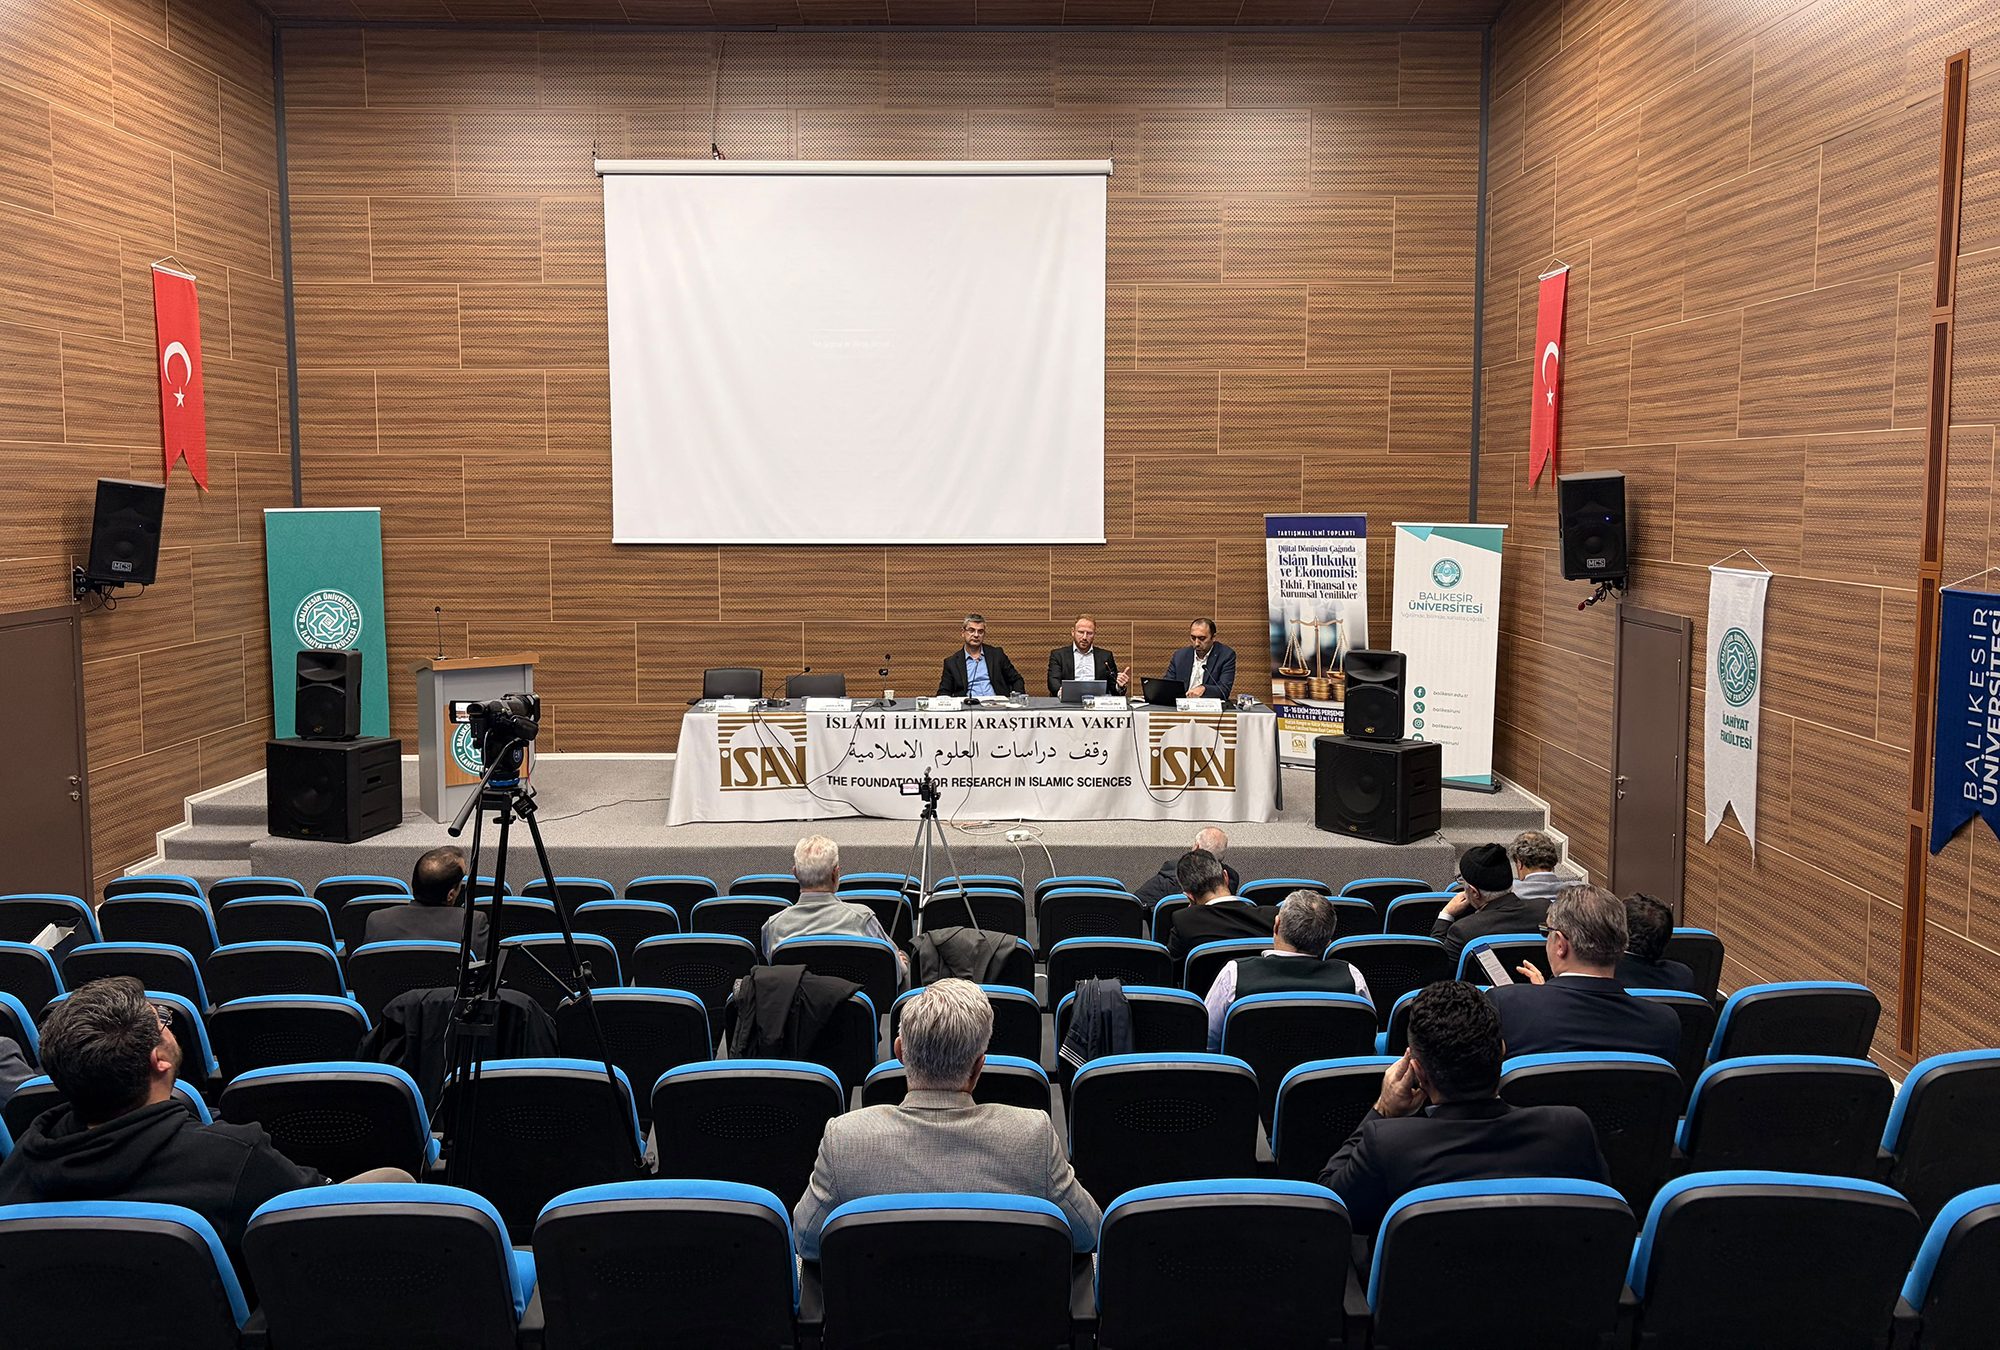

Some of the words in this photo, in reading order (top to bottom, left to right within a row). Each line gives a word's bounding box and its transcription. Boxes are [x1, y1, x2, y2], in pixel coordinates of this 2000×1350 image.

[1311, 555, 1356, 567] Hukuku
[1588, 559, 1604, 567] MCS
[1280, 567, 1292, 577] ve
[1295, 566, 1358, 578] Ekonomisi:
[1307, 580, 1345, 591] Finansal
[1347, 583, 1358, 591] ve
[1280, 590, 1317, 598] Kurumsal
[1320, 591, 1358, 599] Yenilikler
[1419, 592, 1473, 602] BALIKESİR
[298, 594, 322, 623] BALIKESİR
[323, 592, 359, 620] ÜNİVERSİTESİ
[1408, 600, 1483, 614] ÜNİVERSİTESİ
[300, 629, 327, 649] İLAHİYAT
[1963, 608, 1988, 800] BALIKESİR
[1979, 610, 2000, 805] ÜNİVERSİTESİ
[1318, 714, 1344, 722] ÜNİVER
[1321, 709, 1344, 718] PERŞEMB
[826, 714, 886, 729] İSLÂMÎ
[895, 715, 967, 729] İLİMLER
[974, 716, 1074, 731] ARAŞTIRMA
[1081, 717, 1132, 729] VAKFI
[456, 723, 471, 747] BALIKE
[848, 739, 923, 763] الاسلامية
[934, 740, 979, 768] العلوم
[990, 740, 1057, 764] دراسات
[1069, 742, 1108, 765] وقف
[459, 753, 484, 772] İLAHİYAT
[826, 776, 847, 787] THE
[951, 777, 1011, 787] RESEARCH
[1014, 777, 1025, 787] IN
[1029, 777, 1074, 787] ISLAMIC
[1077, 777, 1132, 787] SCIENCES
